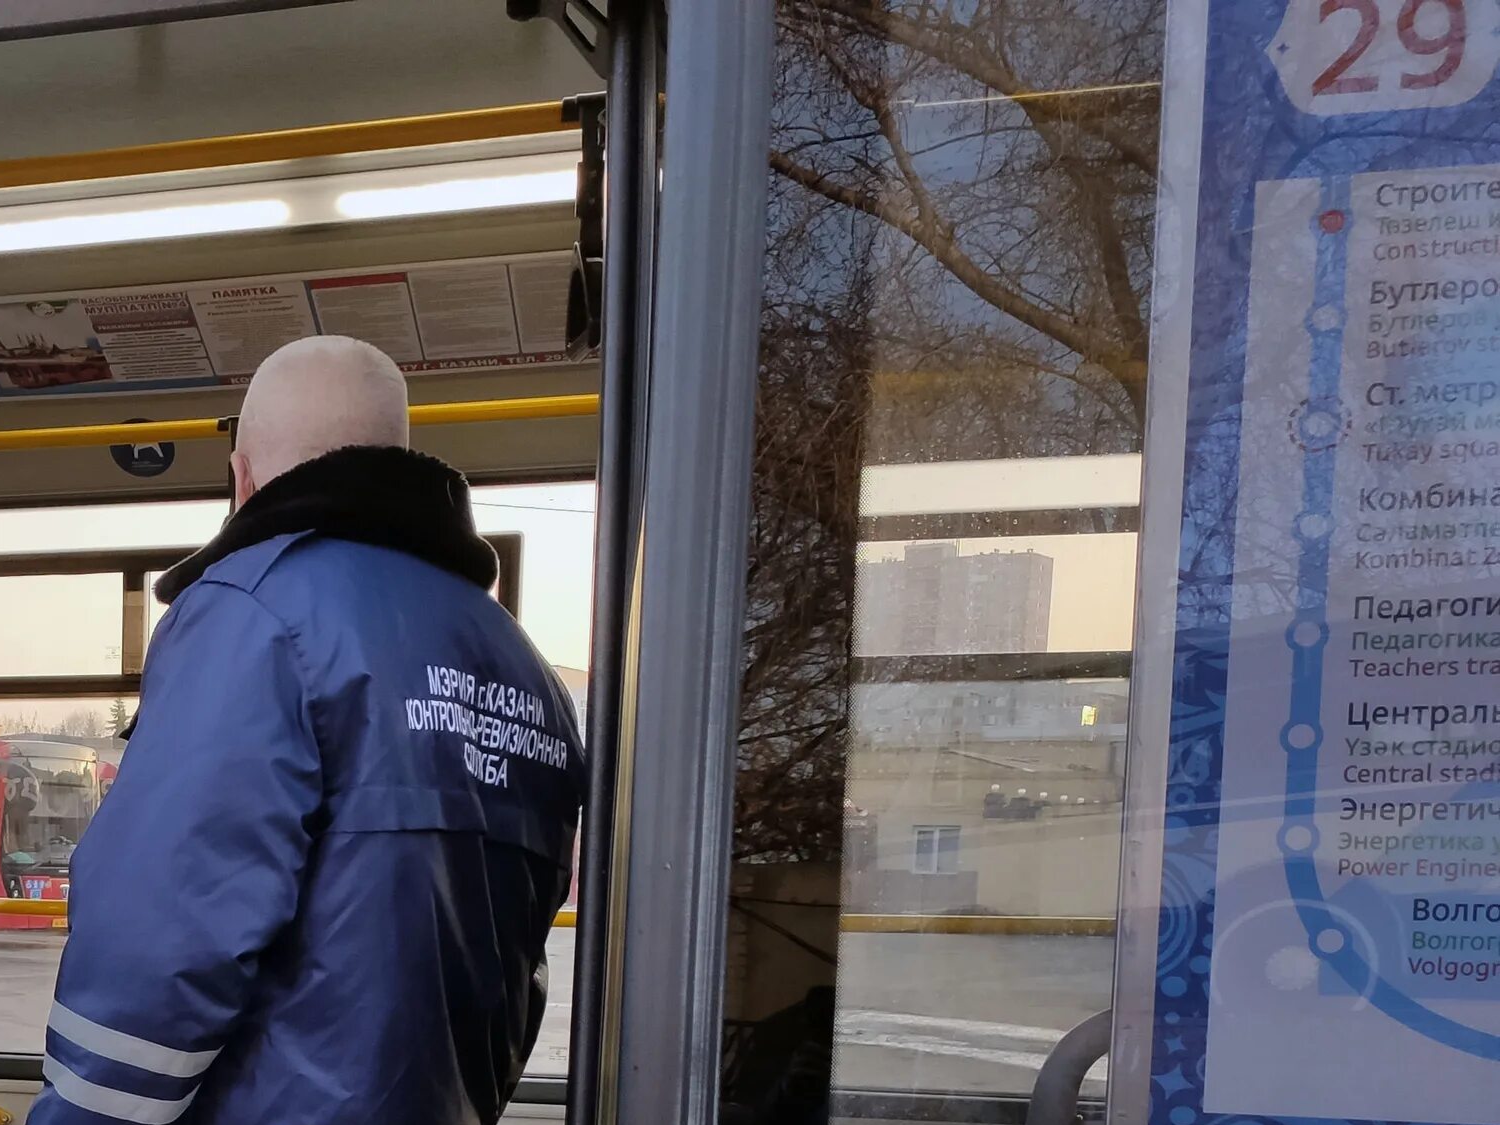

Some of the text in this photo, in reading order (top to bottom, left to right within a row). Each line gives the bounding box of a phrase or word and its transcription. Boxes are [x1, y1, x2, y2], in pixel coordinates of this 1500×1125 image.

[1311, 0, 1467, 96] 29
[211, 286, 278, 299] ПАМЯТКА
[1365, 382, 1405, 407] Ст.
[1349, 657, 1460, 678] Teachers
[426, 664, 476, 705] МЭРИЯ
[1343, 762, 1432, 784] Central
[1337, 831, 1484, 856] Энергетика
[1337, 858, 1410, 878] Power
